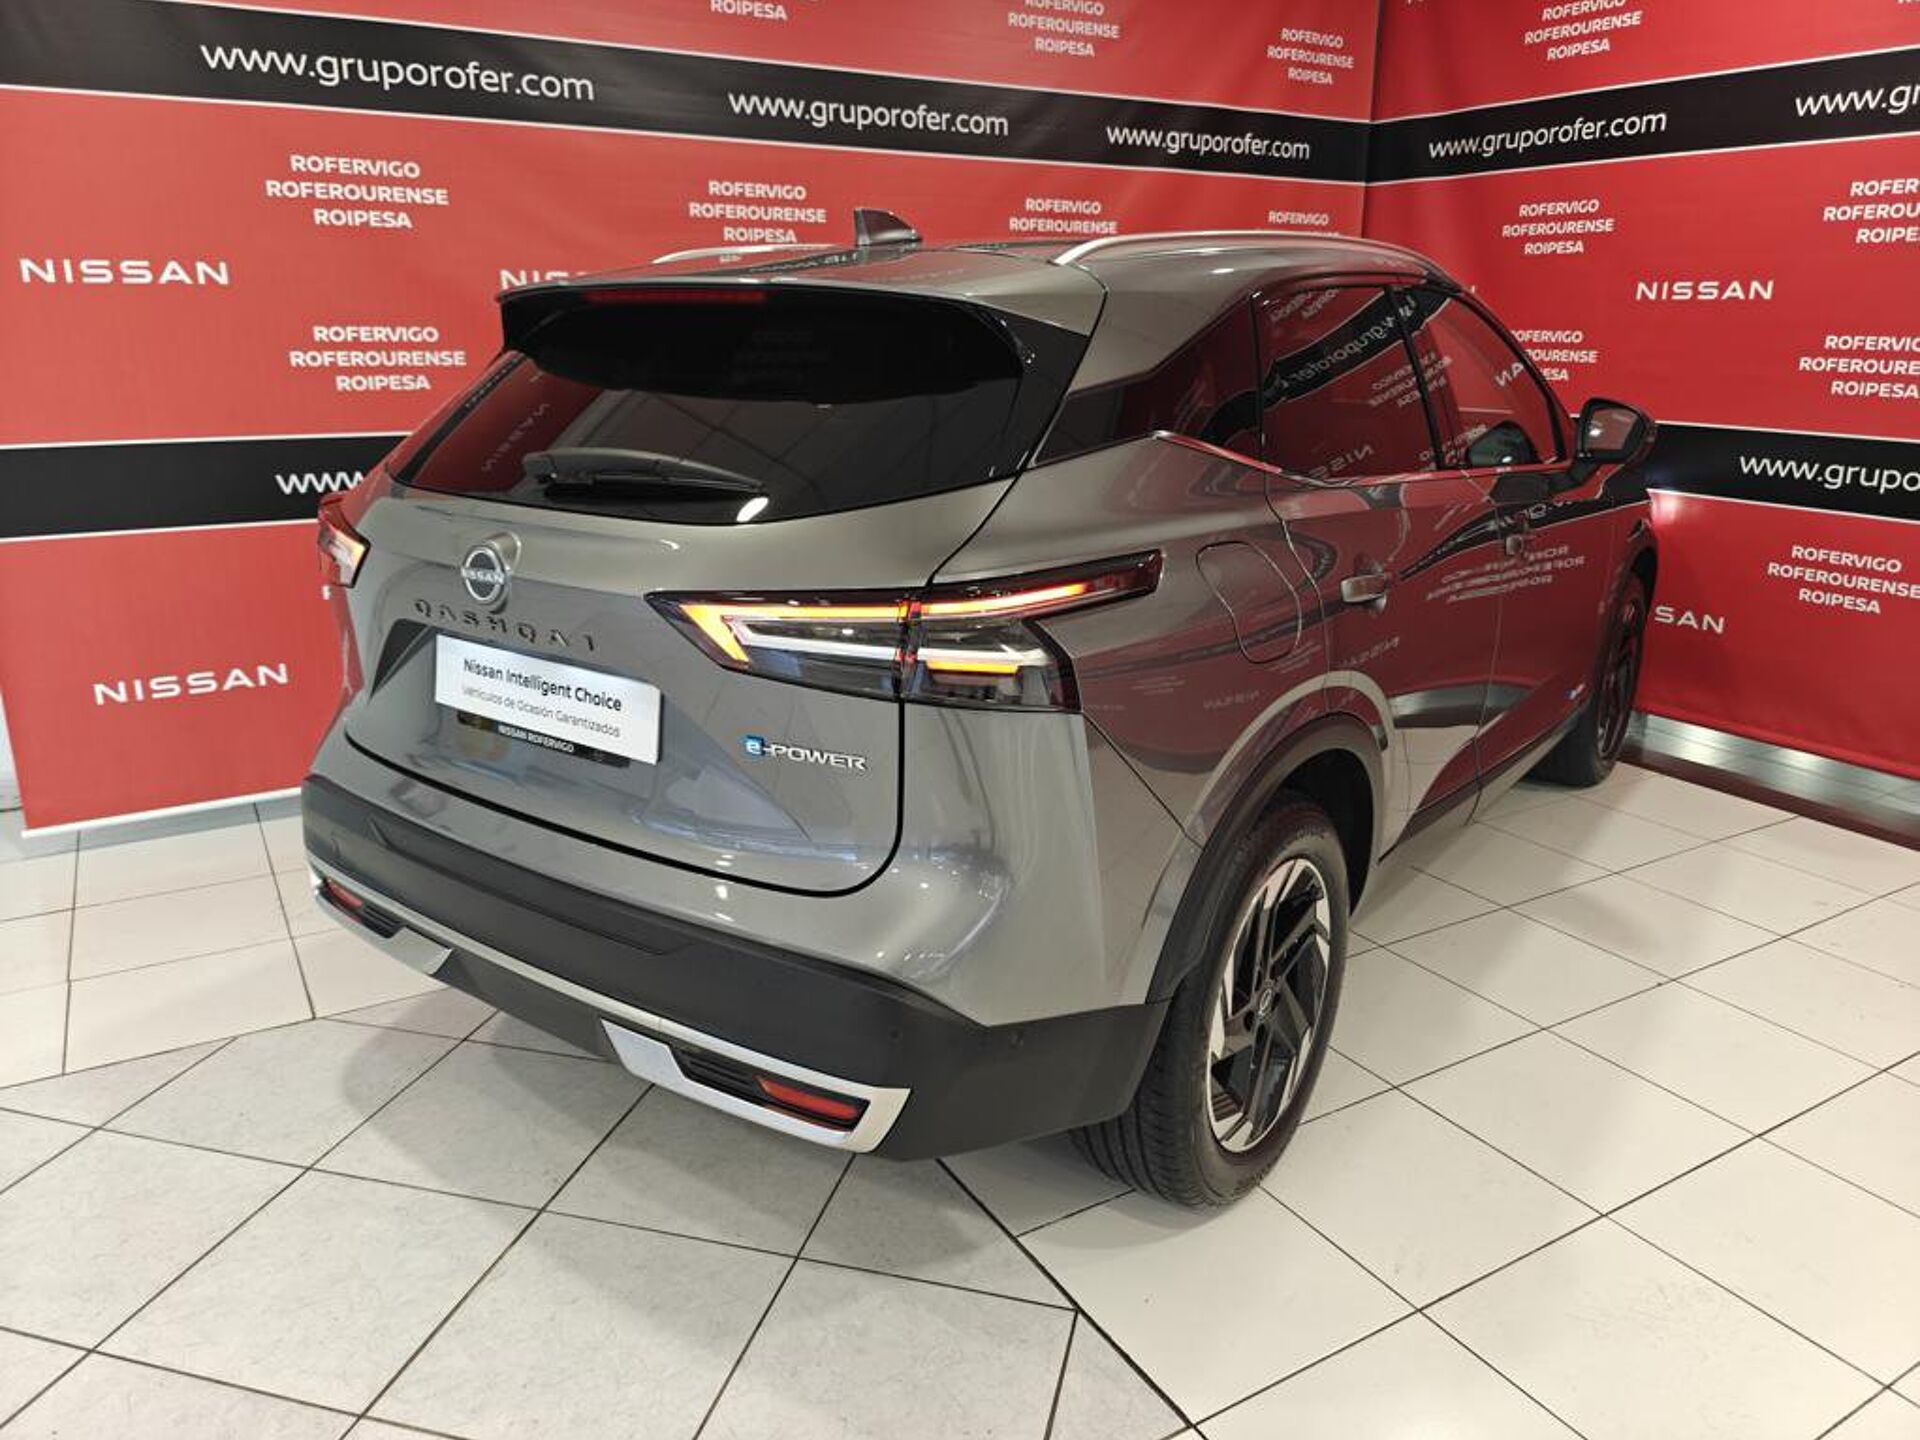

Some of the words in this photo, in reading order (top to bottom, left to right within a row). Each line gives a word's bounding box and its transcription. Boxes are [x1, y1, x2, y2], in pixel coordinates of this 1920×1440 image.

[710, 0, 788, 20] ROIPESA
[1008, 12, 1119, 39] ROFEROURENSE
[1525, 10, 1642, 44] ROFEROURENSE
[1035, 37, 1095, 57] ROIPESA
[1280, 27, 1344, 48] ROFERVIGO
[1267, 44, 1354, 68] ROFEROURENSE
[1544, 37, 1611, 60] ROIPESA
[200, 44, 595, 101] www.gruporofer.com
[1288, 66, 1333, 85] ROIPESA
[728, 92, 1009, 136] www.gruporofer.com
[1106, 125, 1311, 160] www.gruporofer.com
[1428, 110, 1668, 159] www.gruporofer.com
[290, 154, 420, 179] ROFERVIGO
[265, 179, 449, 206] ROFEROURENSE
[708, 180, 807, 200] ROFERVIGO
[688, 202, 827, 223] ROFEROURENSE
[1025, 197, 1102, 215] ROFERVIGO
[1519, 198, 1600, 217] ROFERVIGO
[313, 208, 413, 228] ROIPESA
[1009, 217, 1117, 234] ROFEROURENSE
[1268, 210, 1330, 226] ROFERVIGO
[1502, 218, 1615, 237] ROFEROURENSE
[723, 226, 797, 244] ROIPESA
[1524, 240, 1584, 255] ROIPESA
[20, 258, 229, 285] NISSAN
[1636, 280, 1774, 300] NISSAN
[313, 326, 439, 343] ROFERVIGO
[289, 350, 467, 368] ROFEROURENSE
[335, 375, 431, 391] ROIPESA
[1831, 381, 1920, 399] ROIPESA
[1791, 545, 1902, 574] ROFERVIGO
[1767, 562, 1920, 600] ROFEROURENSE
[1799, 587, 1881, 613] ROIPESA
[415, 599, 595, 652] QASHQAI
[93, 663, 288, 705] NISSAN
[464, 658, 503, 681] Nissan
[506, 669, 572, 698] Intelligent
[574, 686, 622, 712] Choice
